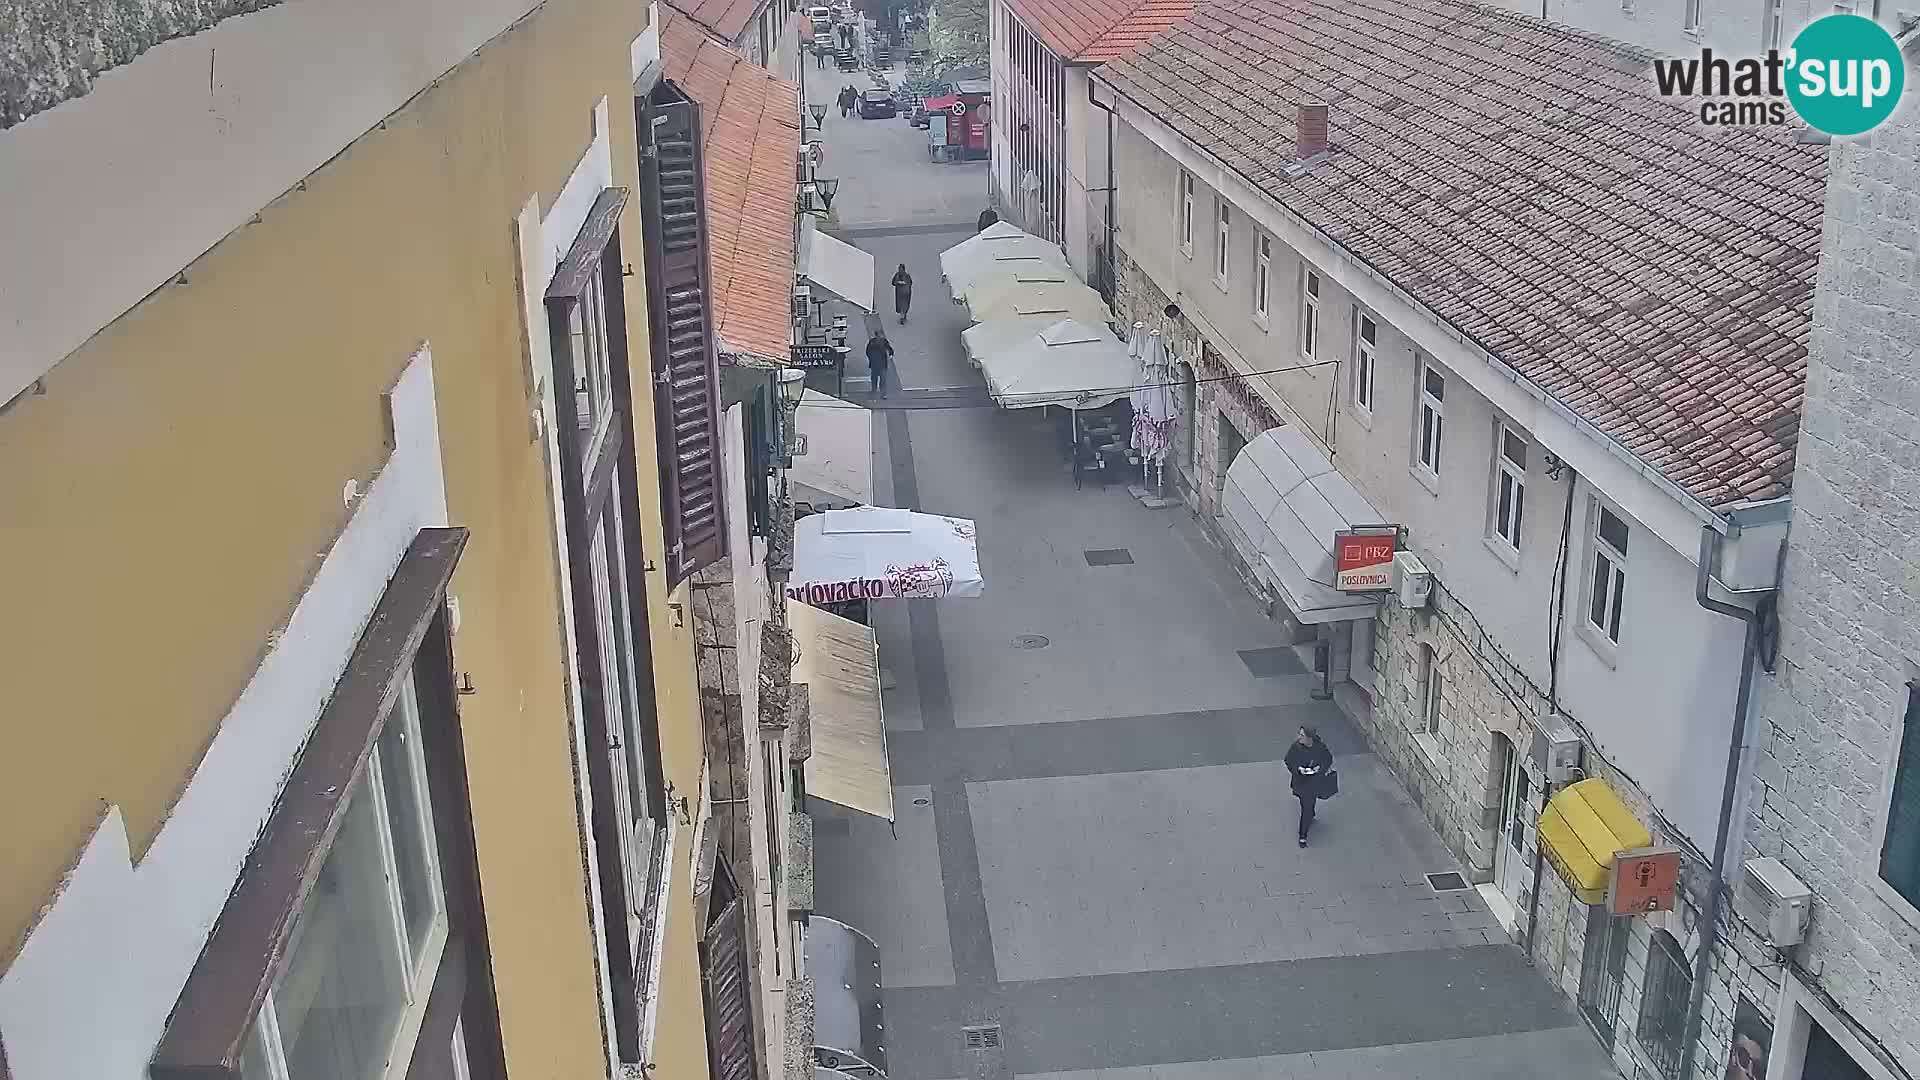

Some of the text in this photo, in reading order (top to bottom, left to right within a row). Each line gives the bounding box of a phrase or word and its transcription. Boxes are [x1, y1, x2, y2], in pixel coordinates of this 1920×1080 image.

[1365, 546, 1390, 559] PBZ
[1341, 574, 1388, 585] POSLOVNICA
[785, 577, 884, 604] arlovačko
